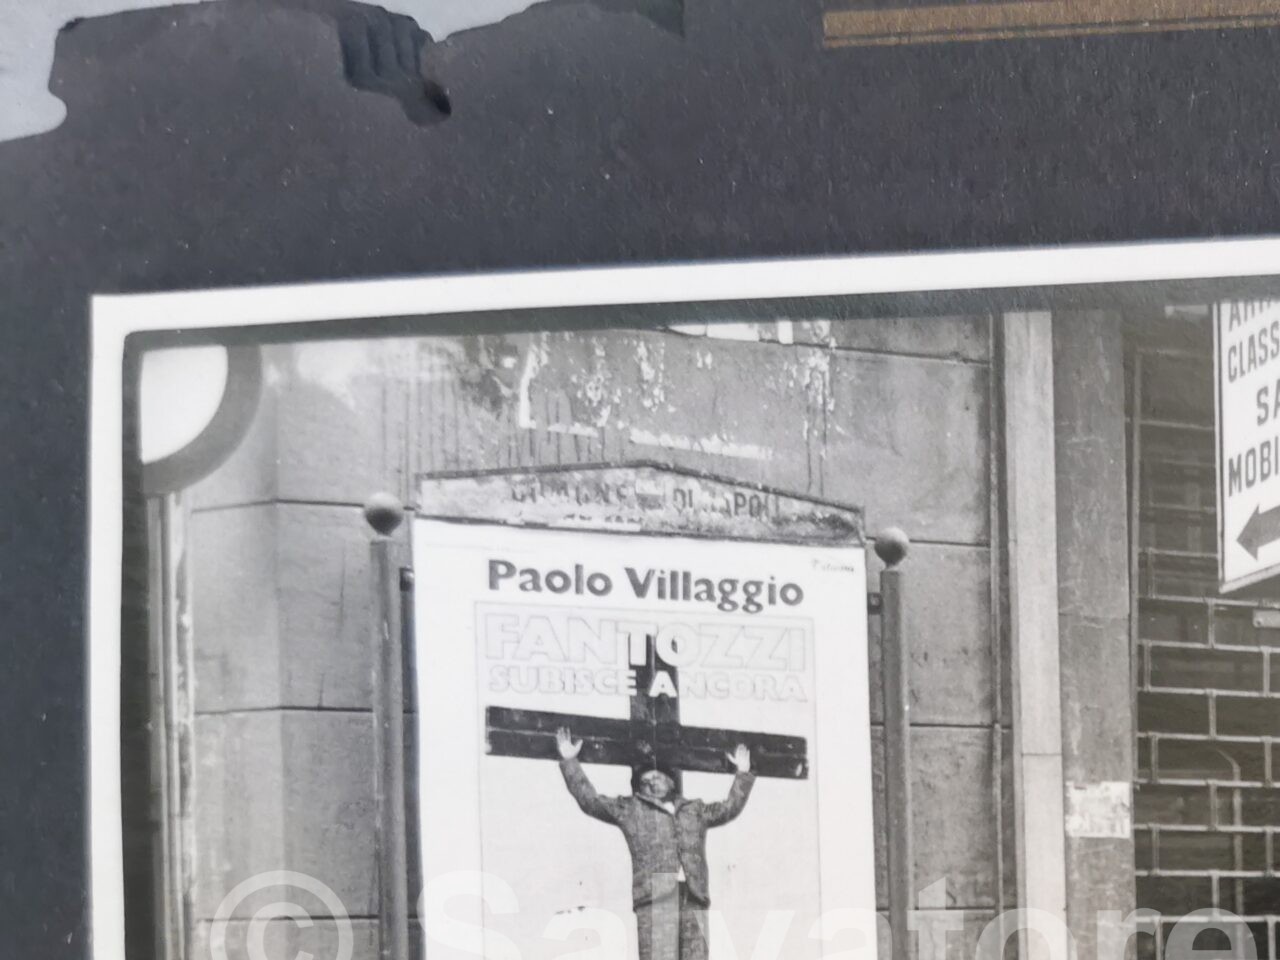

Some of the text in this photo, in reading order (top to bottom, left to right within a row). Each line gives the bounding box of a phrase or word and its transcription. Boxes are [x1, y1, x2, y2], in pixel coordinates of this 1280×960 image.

[488, 559, 612, 597] Paolo
[624, 566, 805, 613] Villaggio
[483, 612, 807, 673] FANTOZZI
[488, 664, 808, 703] SUBISCE ANCORA
